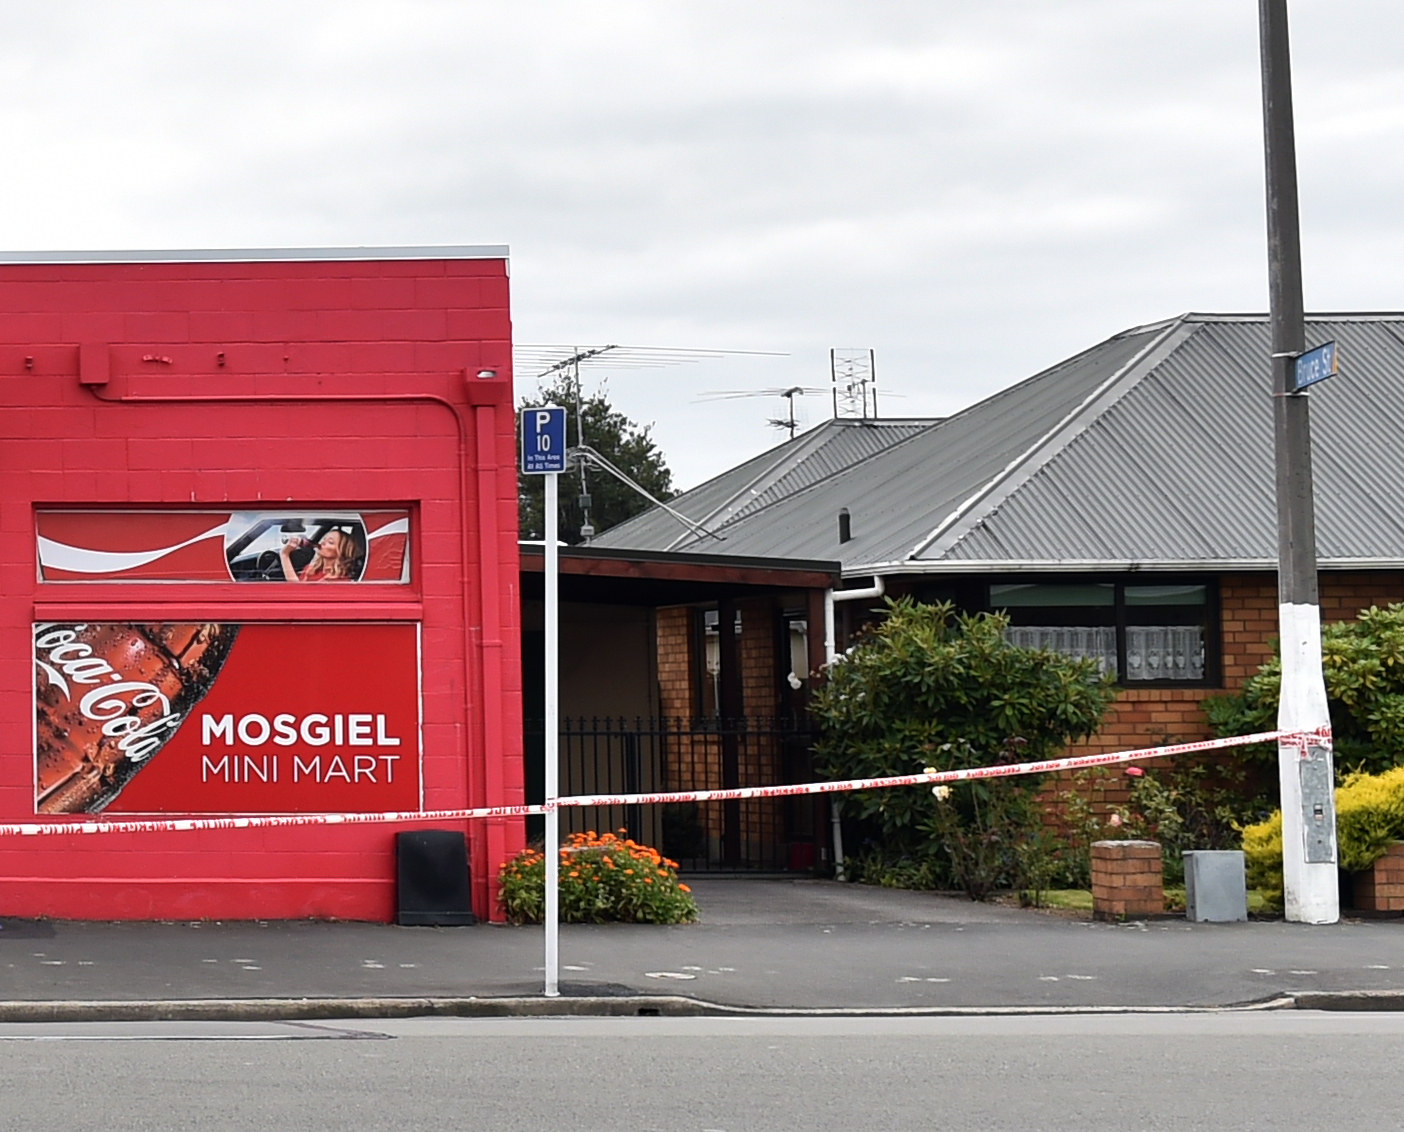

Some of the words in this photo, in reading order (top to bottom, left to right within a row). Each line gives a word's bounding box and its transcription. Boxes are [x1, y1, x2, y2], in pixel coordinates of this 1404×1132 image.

[536, 411, 551, 434] P
[536, 434, 551, 452] 10
[201, 713, 401, 747] MOSGIEL
[202, 755, 278, 783] MINI
[293, 755, 402, 783] MART
